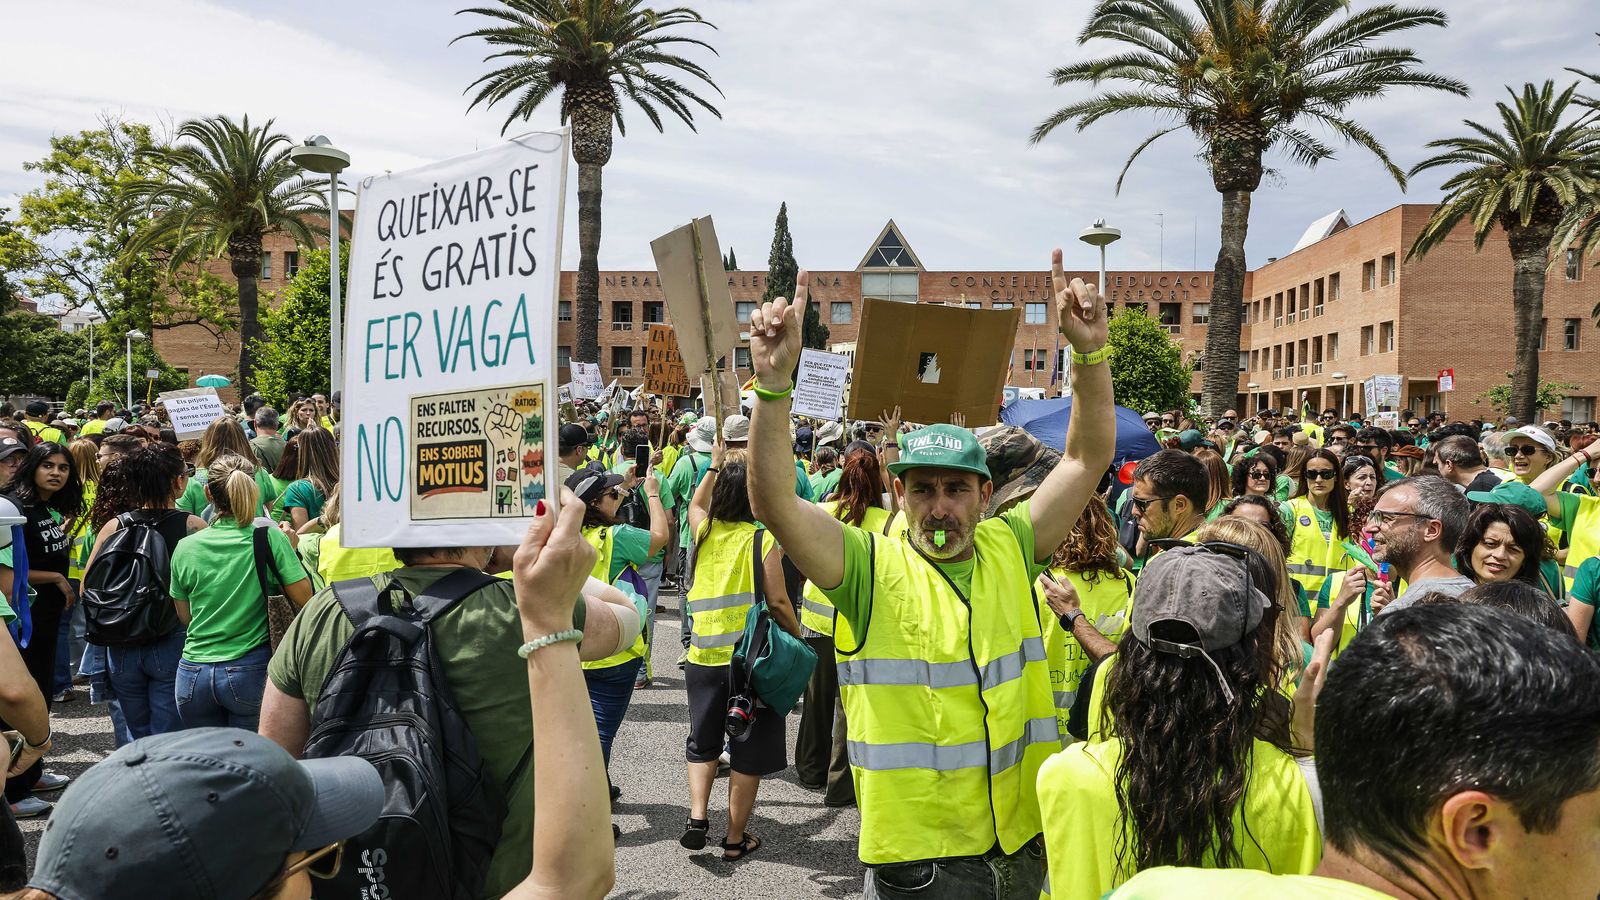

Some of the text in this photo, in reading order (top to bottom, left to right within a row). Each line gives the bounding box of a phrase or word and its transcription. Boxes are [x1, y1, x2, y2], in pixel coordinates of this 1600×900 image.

[373, 223, 537, 300] ÉS GRATIS
[990, 289, 1190, 301] CULTU ESPORT
[365, 293, 536, 383] FER VAGA
[188, 396, 209, 405] pitjors
[417, 398, 476, 418] ENS FALTEN
[417, 417, 482, 438] RECURSOS,
[419, 444, 483, 462] ENS SOBREN
[907, 433, 963, 453] FINLAND
[357, 416, 405, 502] NO
[419, 460, 485, 487] MOTIUS
